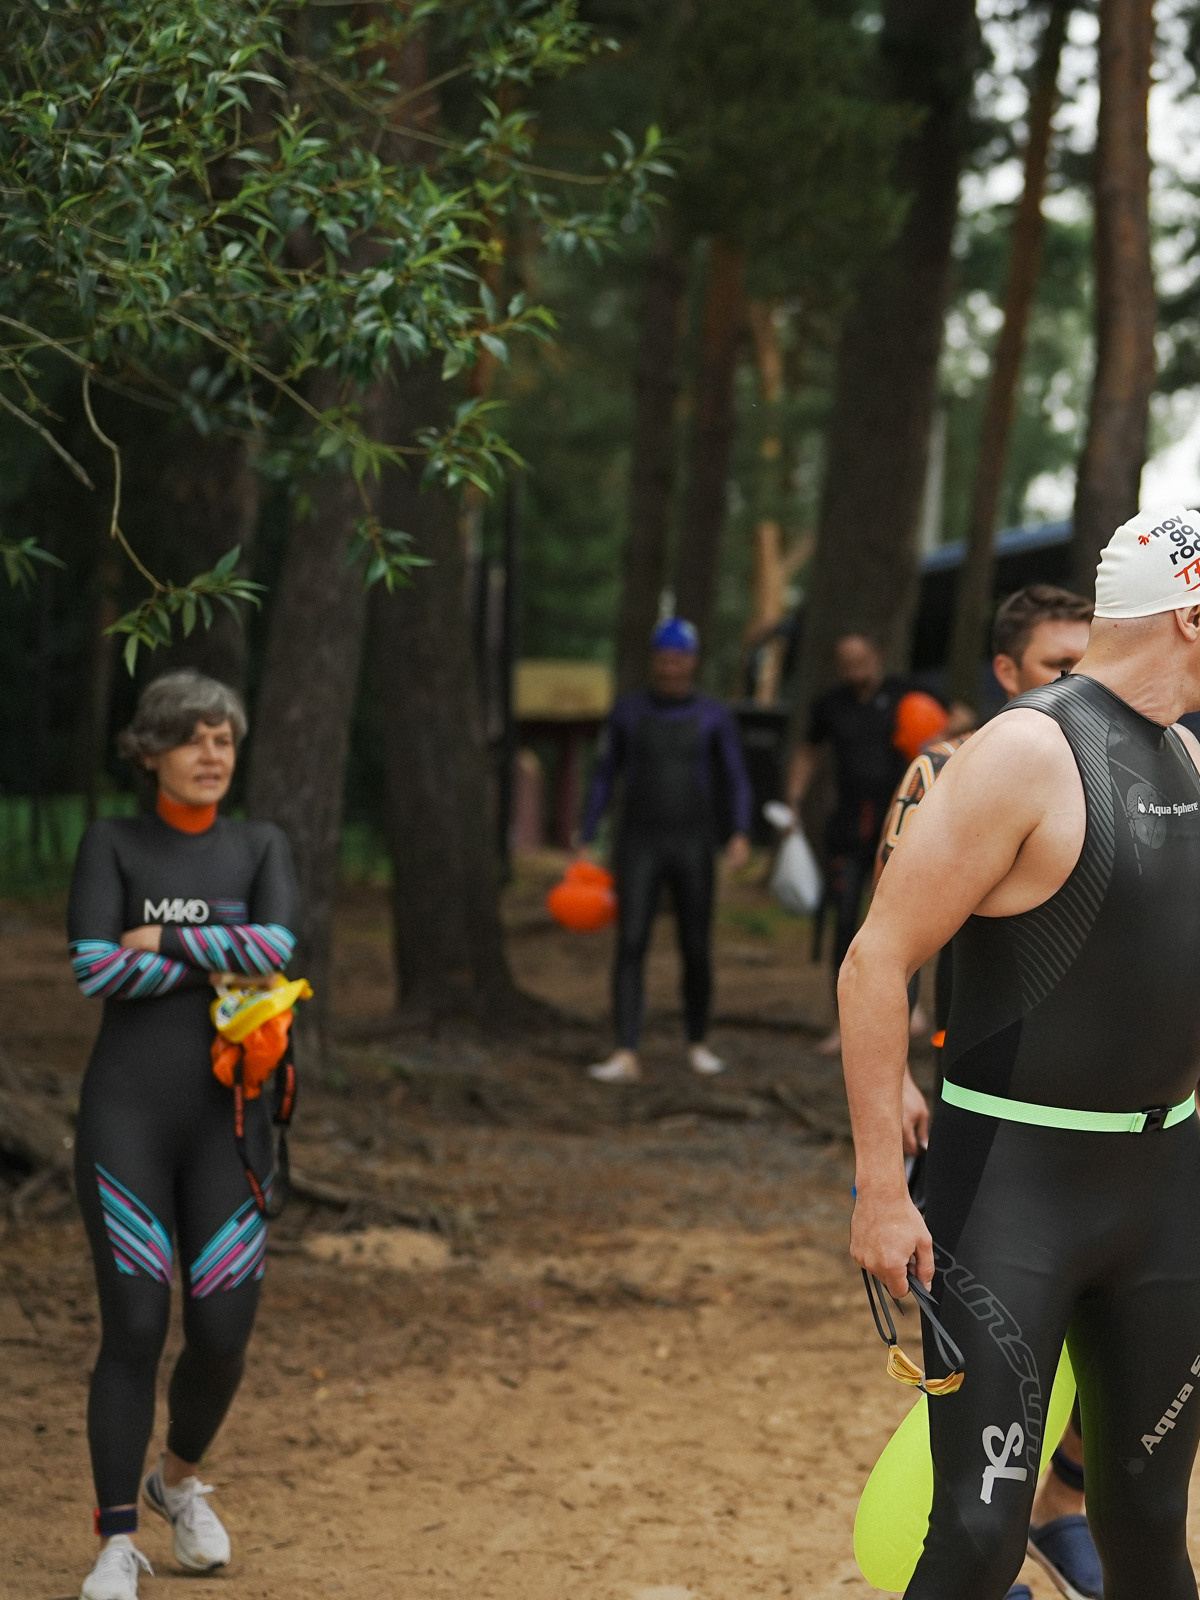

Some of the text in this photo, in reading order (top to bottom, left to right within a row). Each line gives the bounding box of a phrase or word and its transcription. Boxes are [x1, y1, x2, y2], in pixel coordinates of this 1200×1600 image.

[1150, 515, 1183, 538] nov
[1169, 524, 1195, 547] go
[1148, 801, 1199, 816] Aqua Sphere
[144, 898, 210, 923] MAKO
[1140, 1383, 1195, 1456] Aqua
